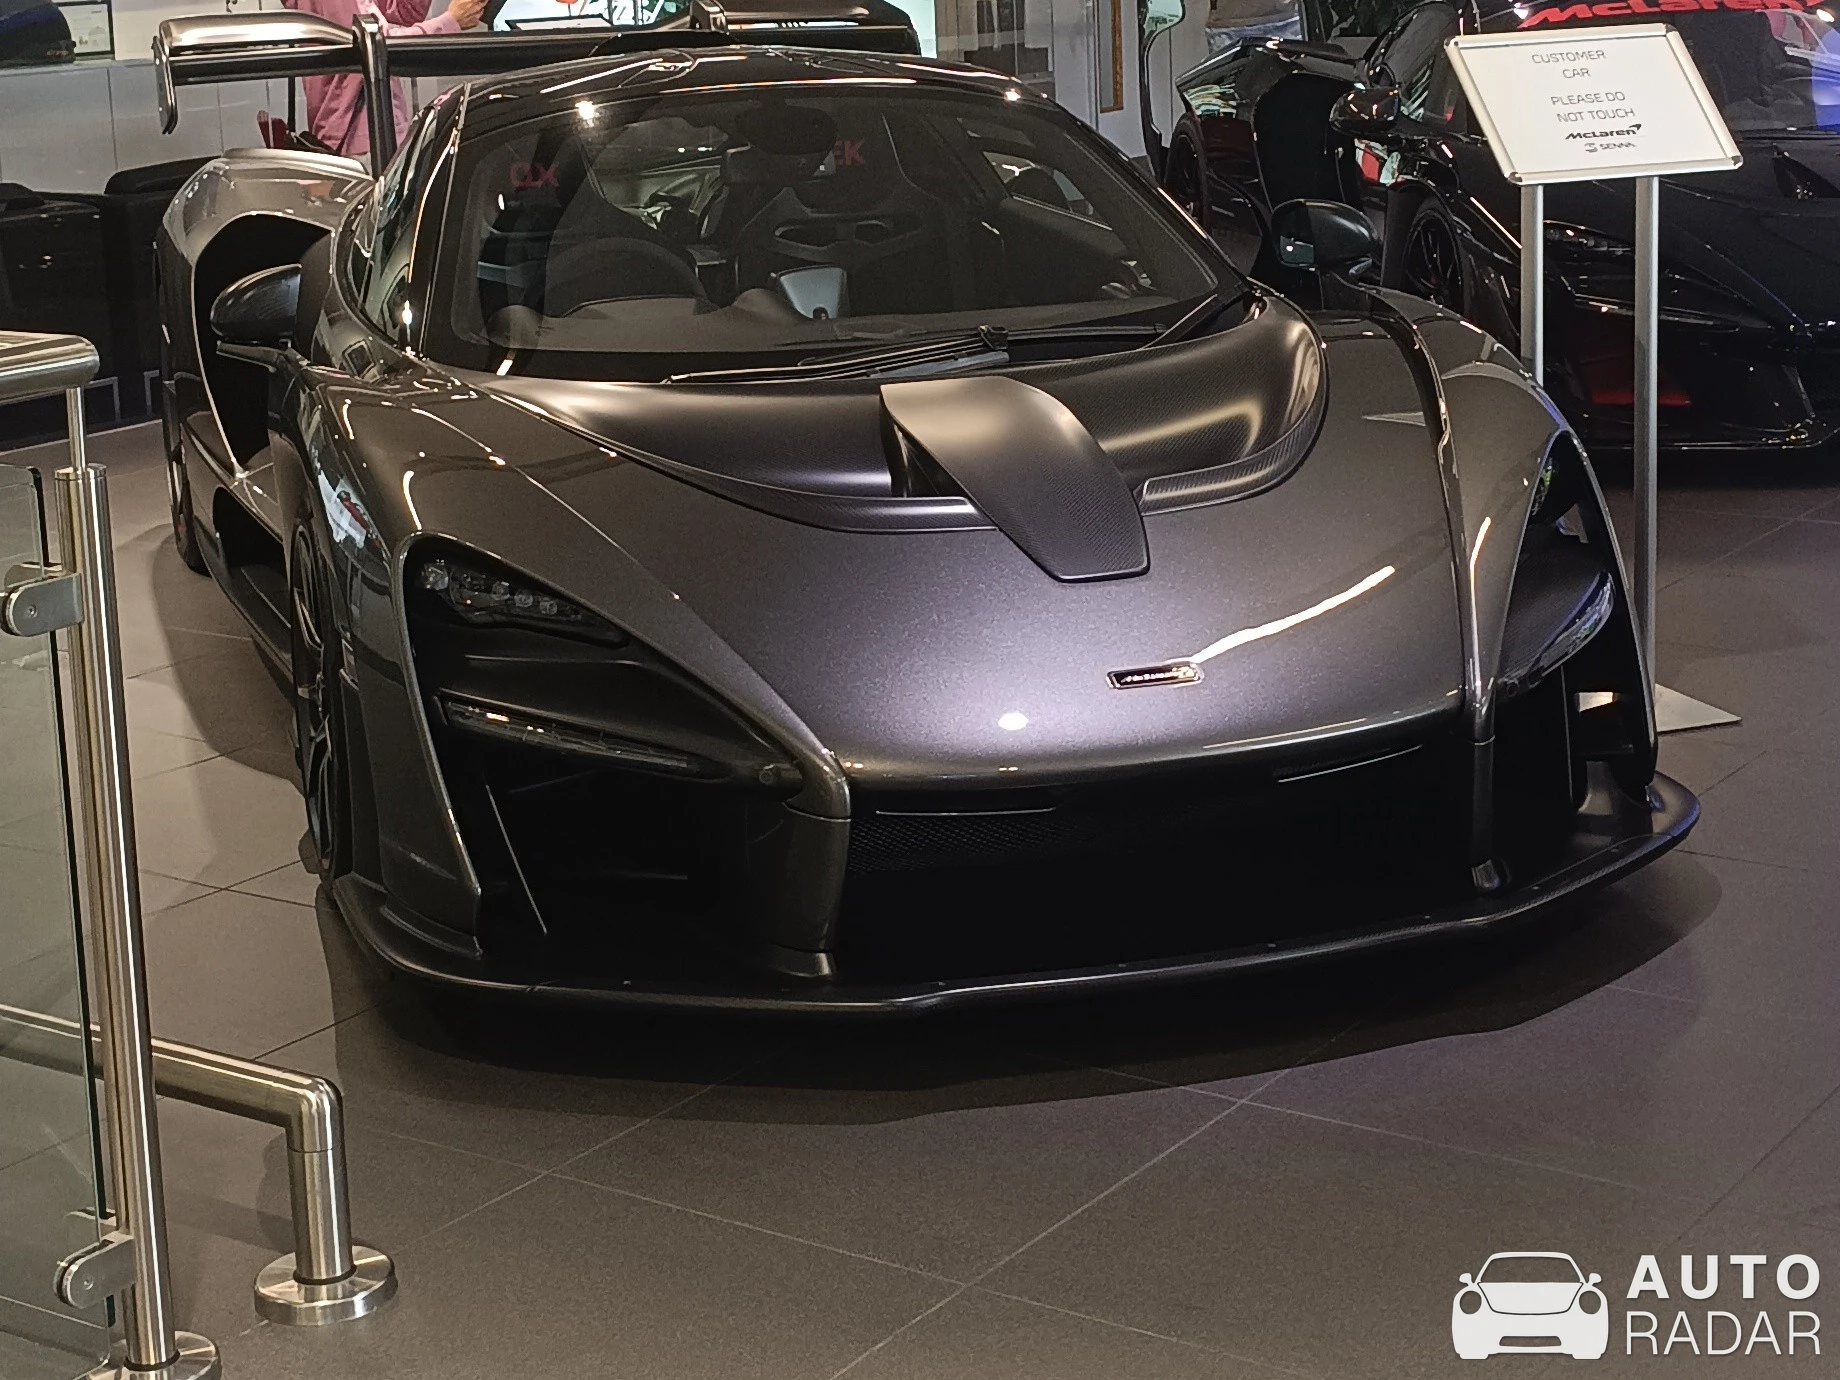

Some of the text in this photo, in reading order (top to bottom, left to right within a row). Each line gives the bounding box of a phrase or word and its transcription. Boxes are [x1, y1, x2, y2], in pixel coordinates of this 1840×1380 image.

[1531, 50, 1606, 63] CUSTOMER
[1562, 68, 1591, 78] CAR
[1550, 91, 1626, 105] PLEASE DO
[1556, 108, 1635, 122] NOT TOUCH
[1565, 126, 1638, 139] McLaren
